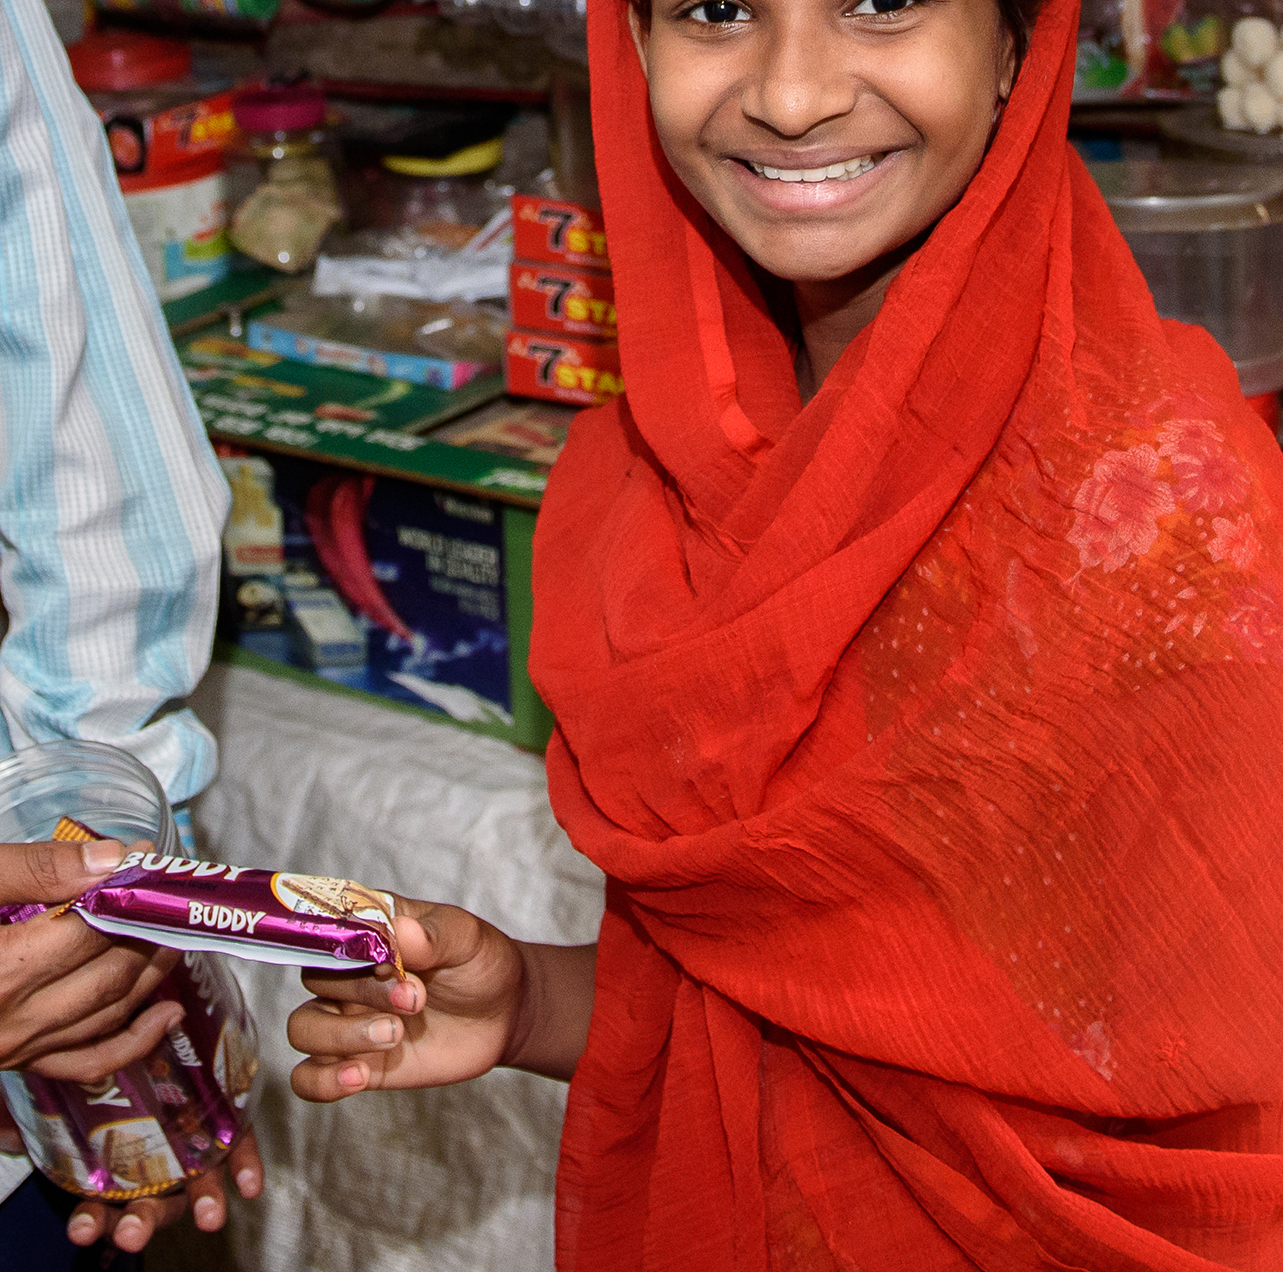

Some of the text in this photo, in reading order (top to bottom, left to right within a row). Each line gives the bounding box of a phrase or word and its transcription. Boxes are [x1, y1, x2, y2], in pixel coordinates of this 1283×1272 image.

[539, 207, 574, 248] 7
[537, 276, 573, 316] 7
[528, 343, 564, 383] 7
[187, 900, 267, 935] BUDDY
